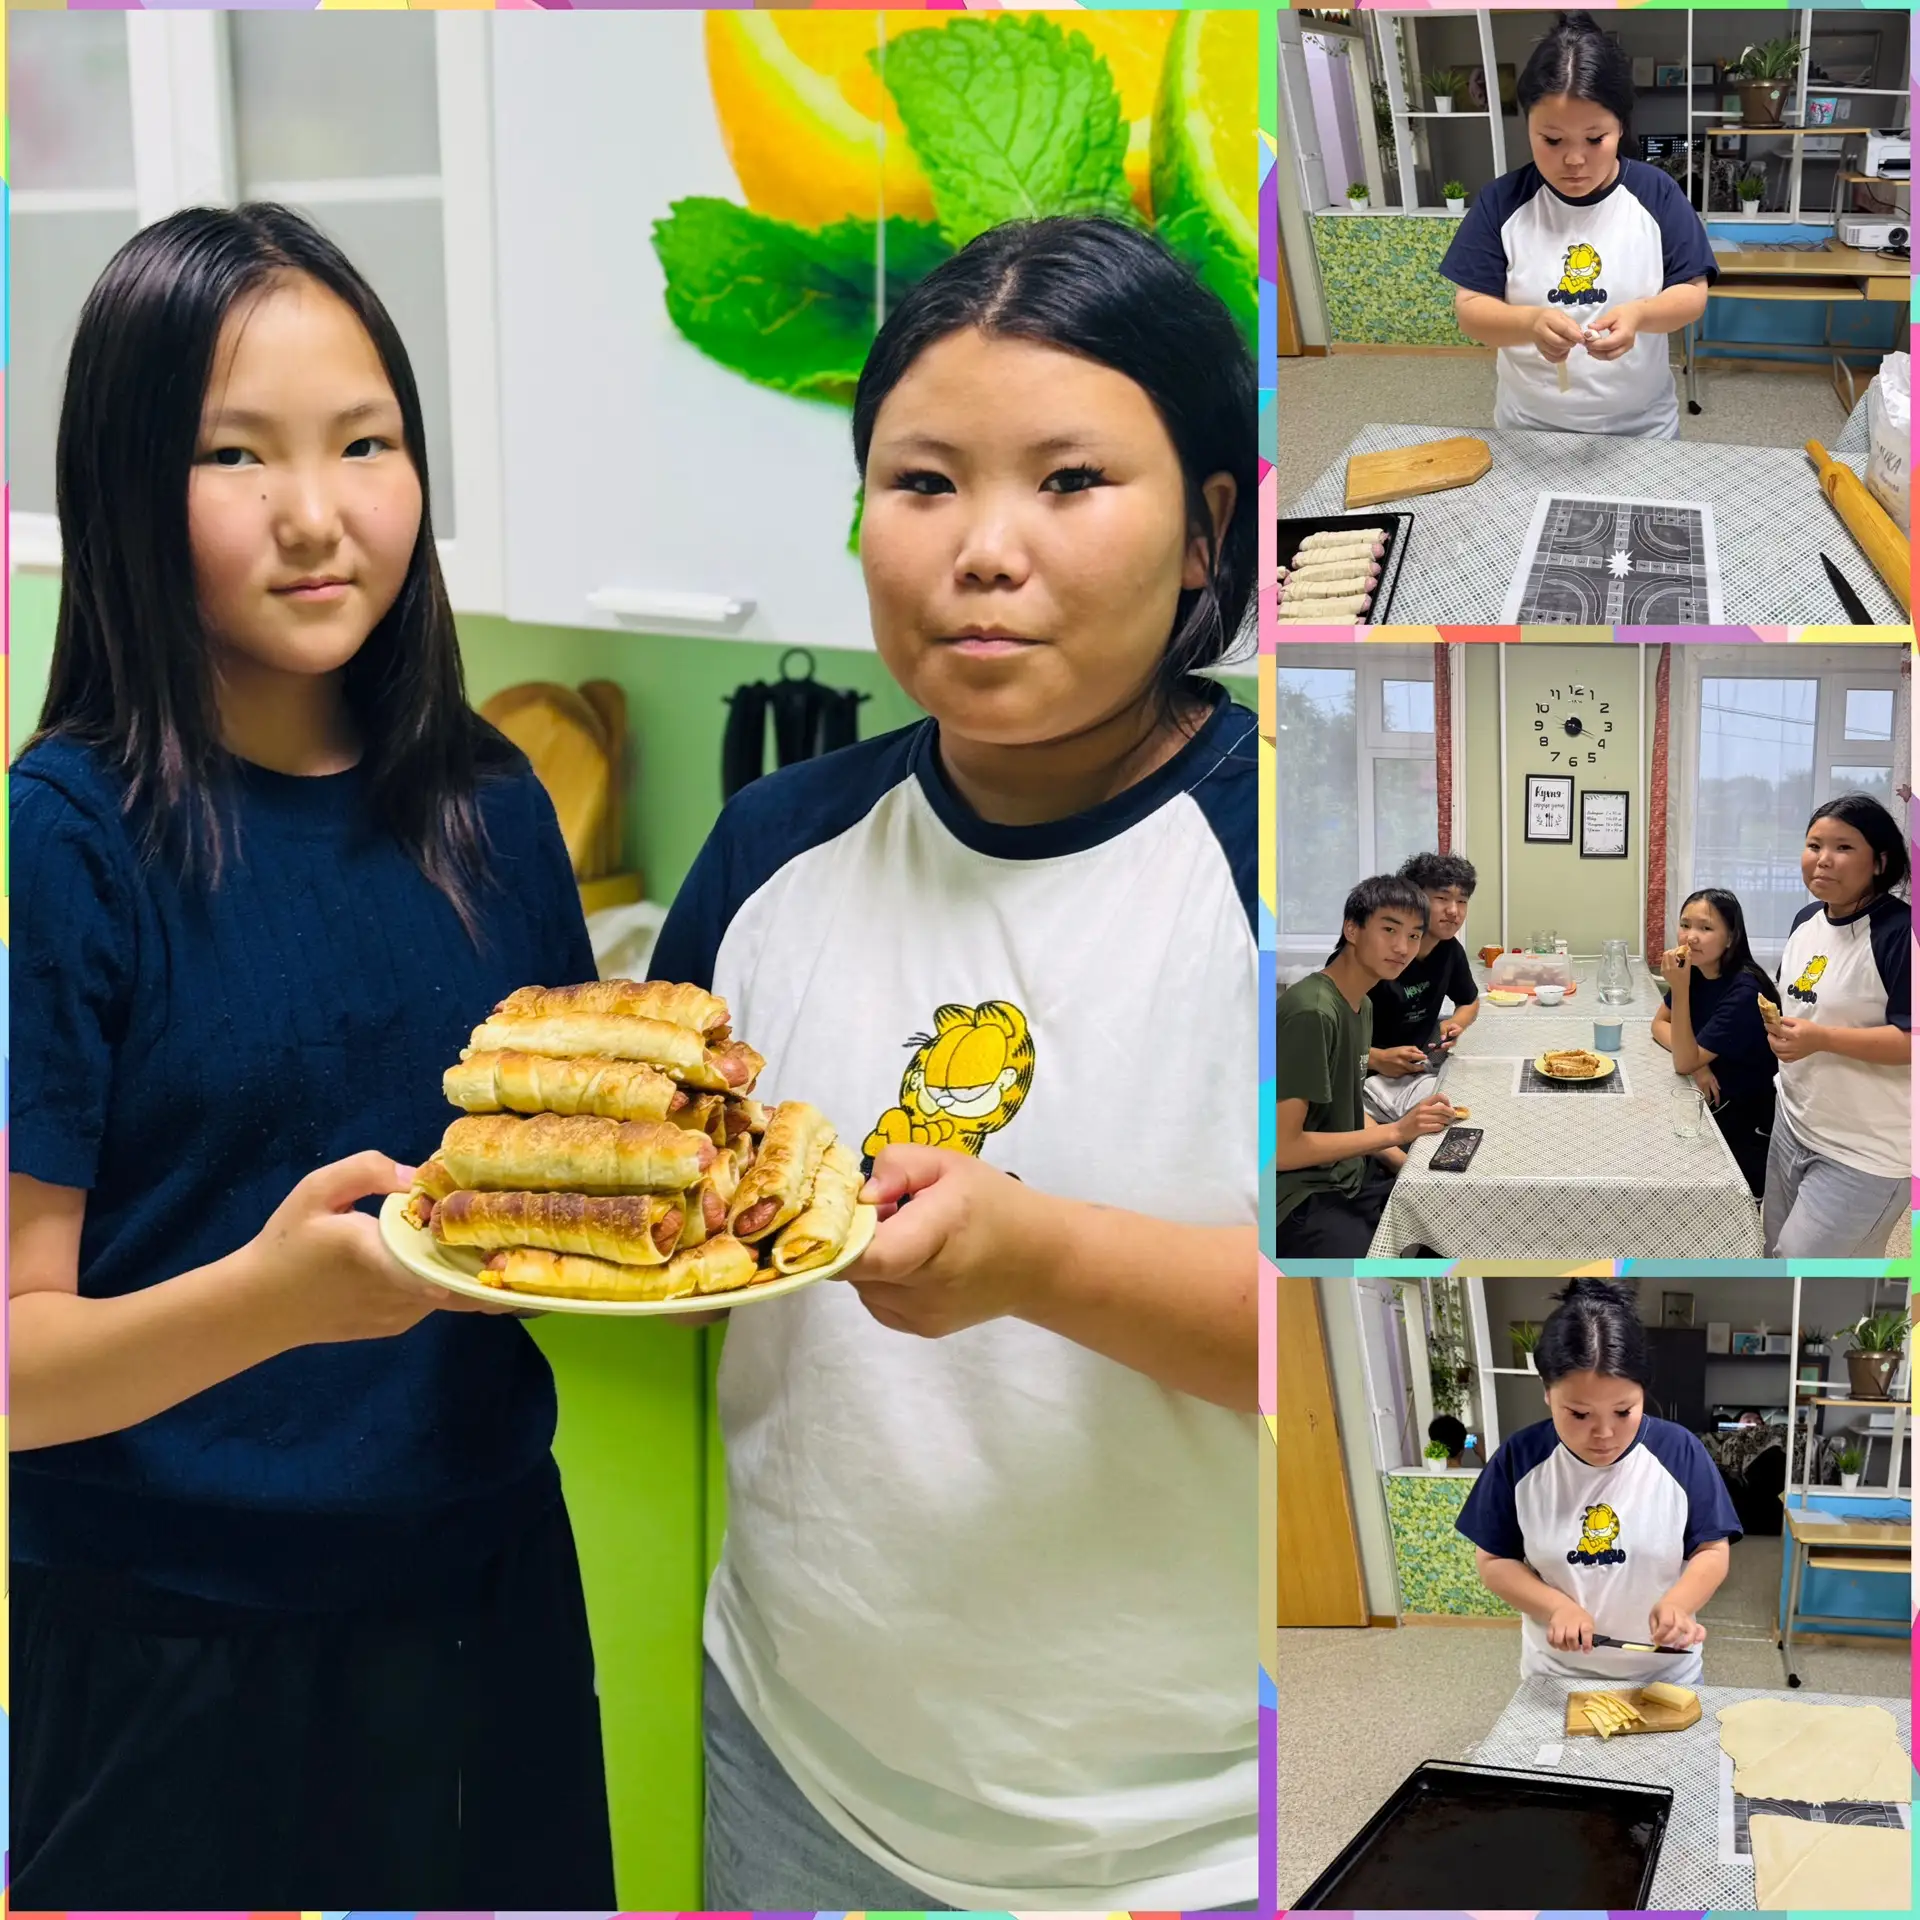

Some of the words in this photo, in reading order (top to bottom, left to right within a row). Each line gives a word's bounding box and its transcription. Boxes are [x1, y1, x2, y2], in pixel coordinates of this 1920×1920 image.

[1550, 689, 1560, 700] 11
[1569, 684, 1584, 696] 12
[1589, 689, 1594, 700] 1
[1536, 703, 1549, 713] 10
[1600, 702, 1609, 713] 2
[1534, 720, 1543, 731] 9
[1604, 721, 1612, 732] 3
[1539, 737, 1548, 747] 8
[1597, 738, 1605, 749] 4
[1550, 751, 1560, 762] 7
[1568, 756, 1578, 767] 6
[1587, 752, 1596, 763] 5
